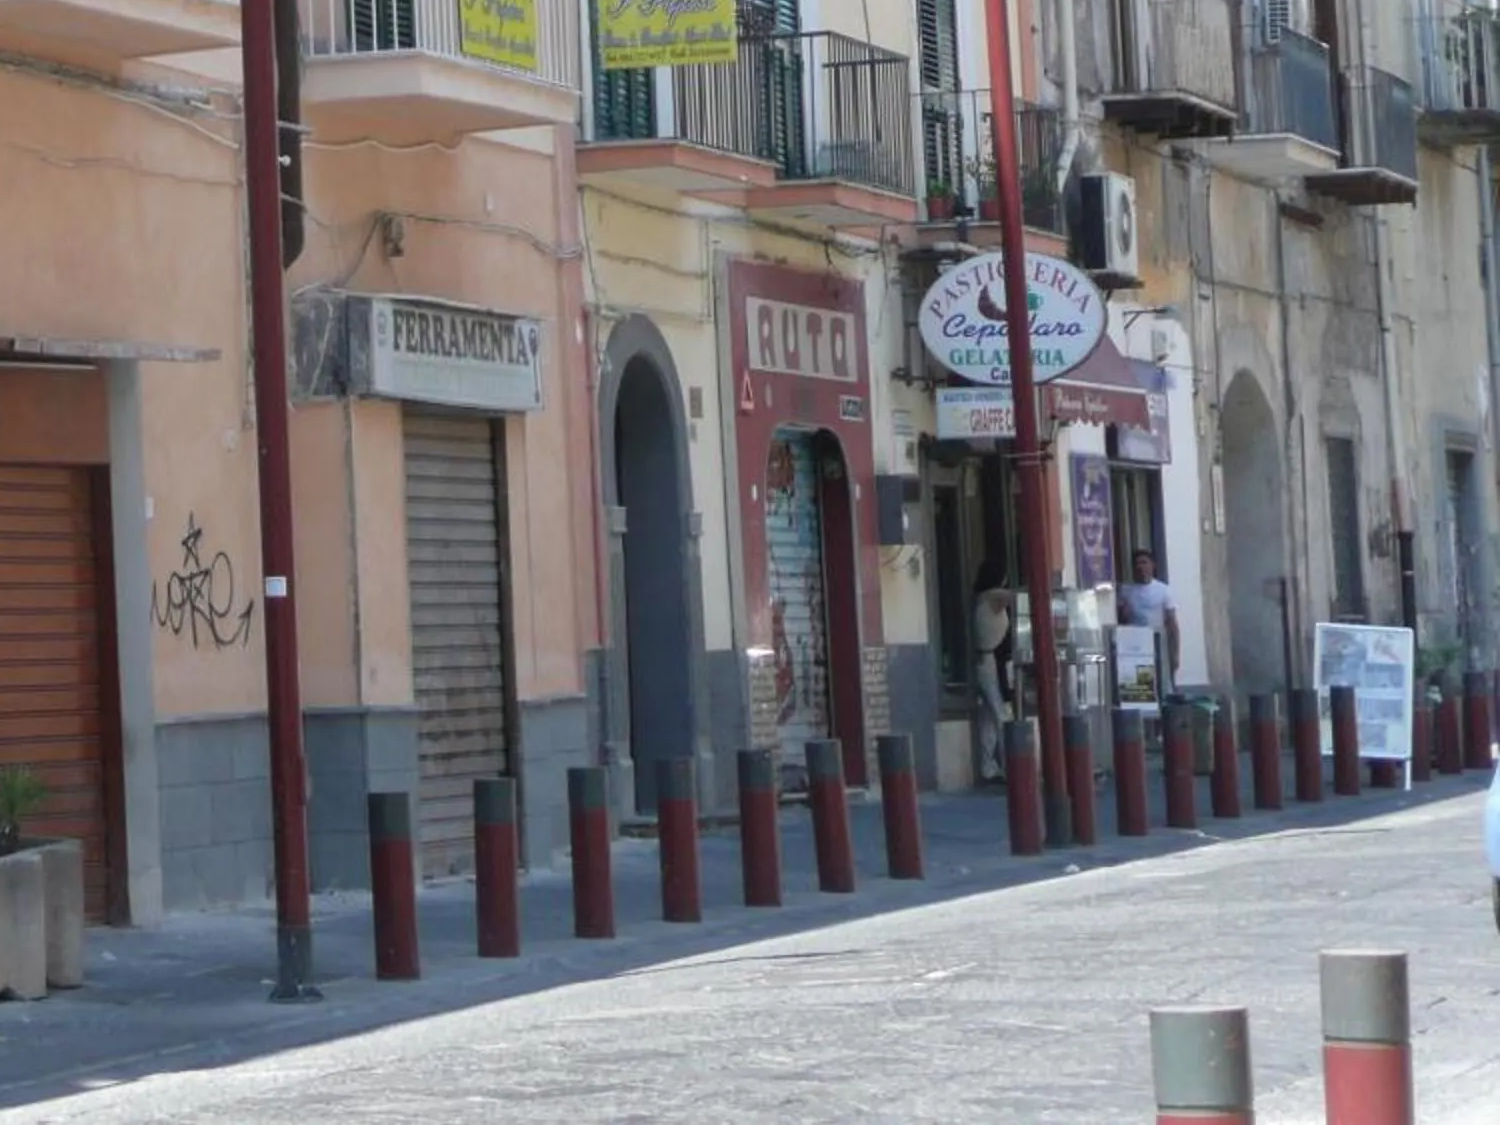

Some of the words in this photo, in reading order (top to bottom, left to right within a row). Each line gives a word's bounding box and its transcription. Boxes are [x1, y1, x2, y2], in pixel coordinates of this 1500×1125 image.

[928, 259, 1093, 321] PASTICERIA
[392, 308, 529, 365] FERRAMENTA
[942, 313, 1085, 347] Cepolaro
